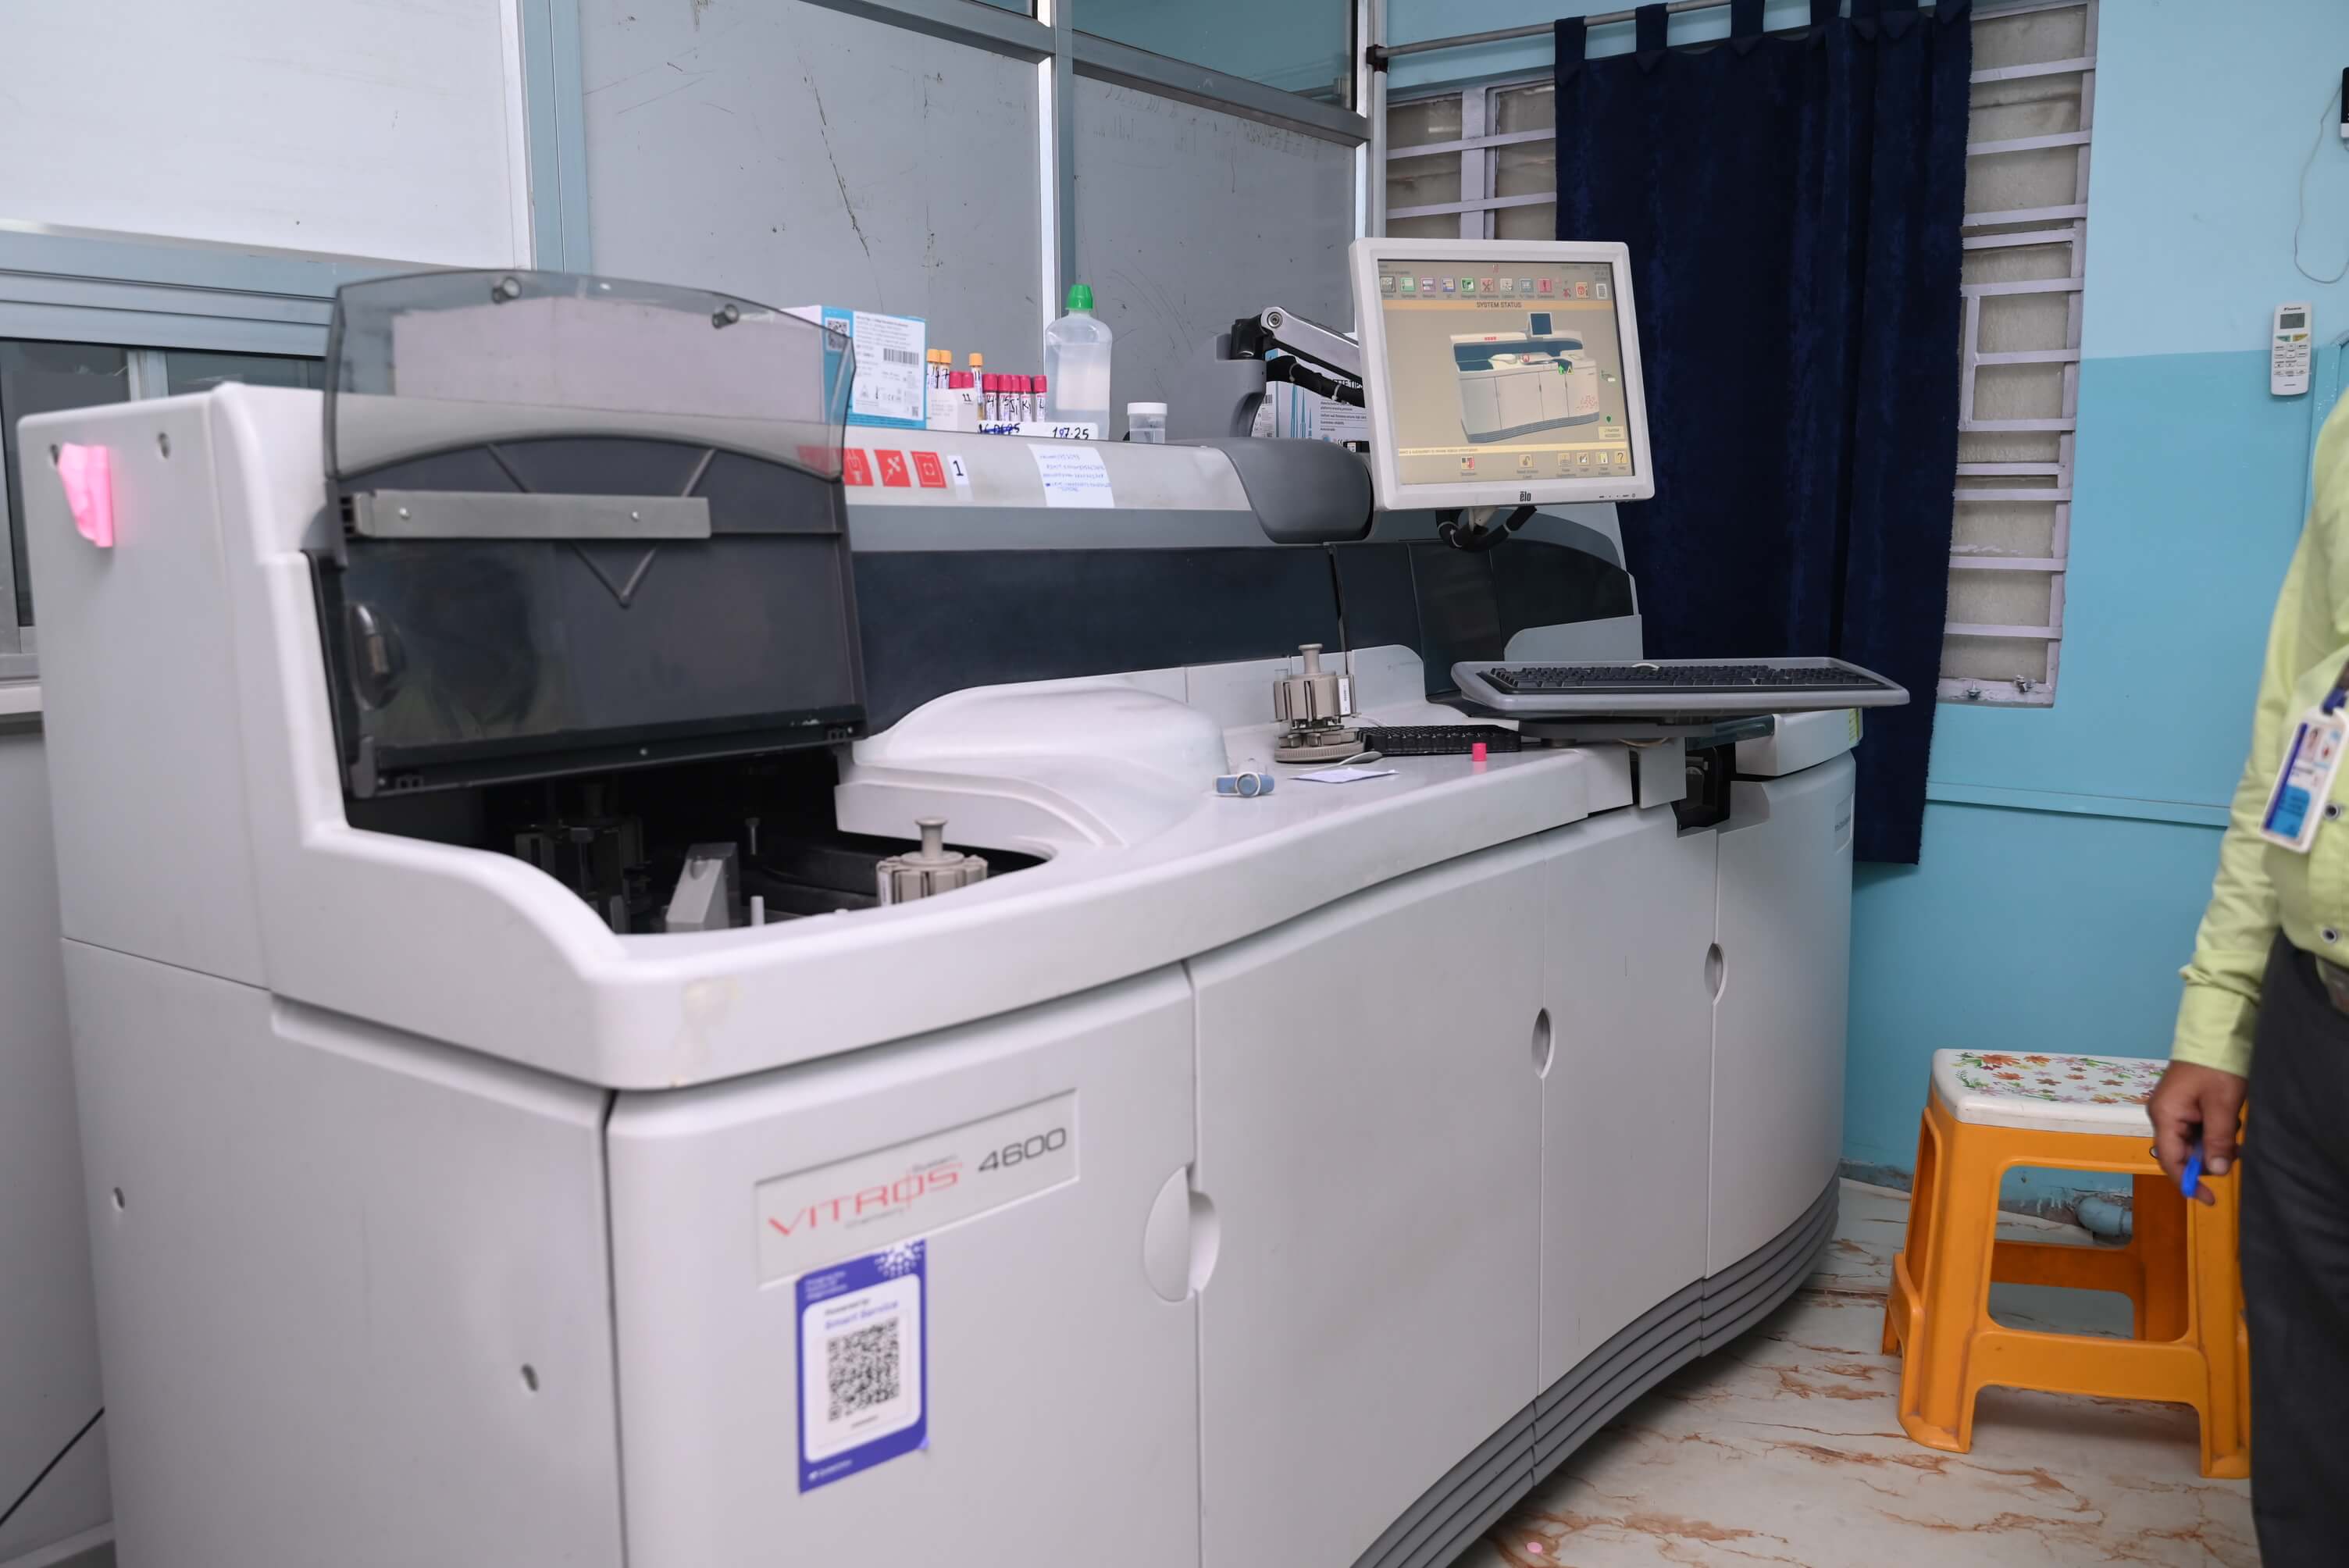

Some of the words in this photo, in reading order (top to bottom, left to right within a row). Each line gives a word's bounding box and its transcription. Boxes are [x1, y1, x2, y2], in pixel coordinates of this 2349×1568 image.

[953, 460, 964, 476] 1
[768, 1162, 963, 1237] VITROS
[978, 1127, 1067, 1172] 4600
